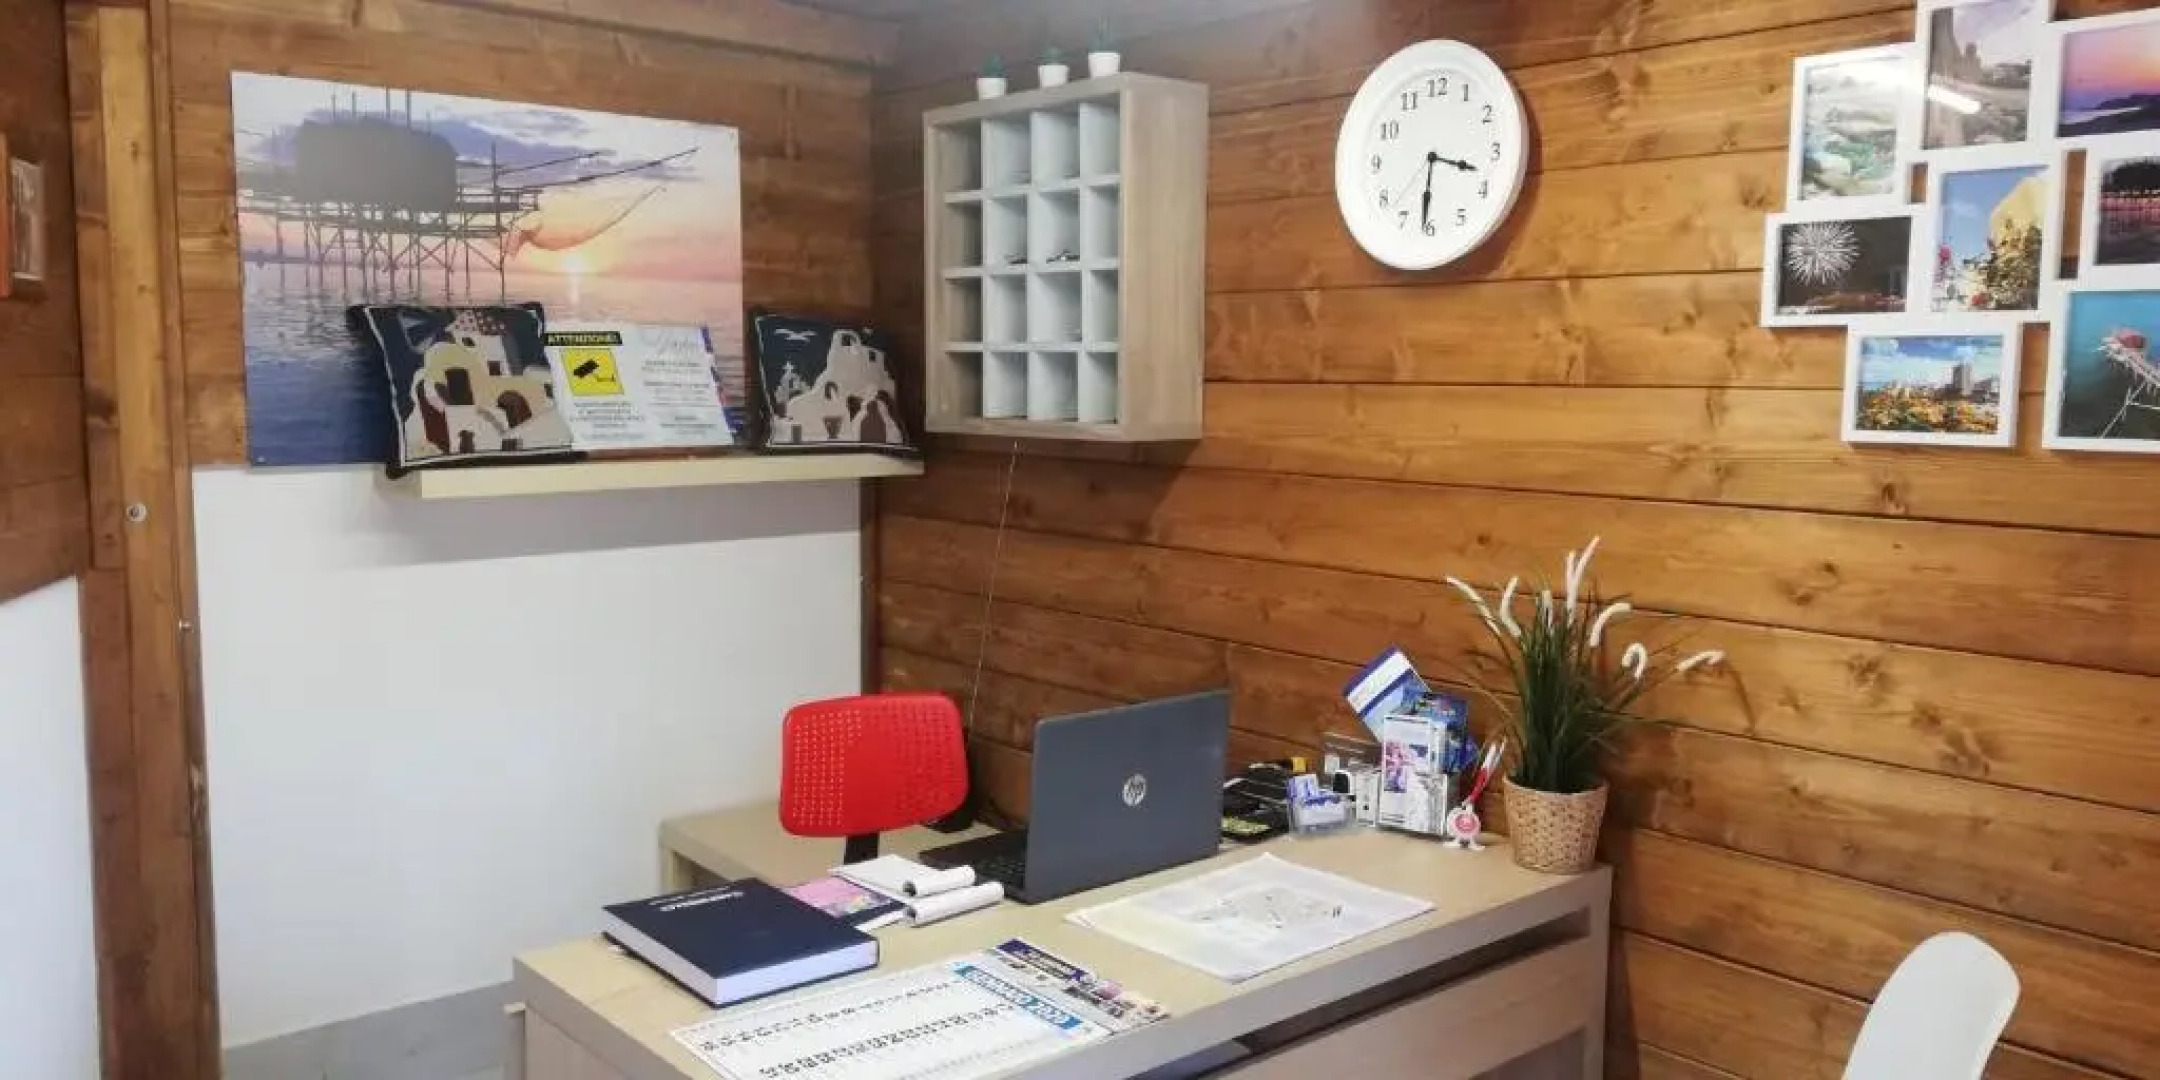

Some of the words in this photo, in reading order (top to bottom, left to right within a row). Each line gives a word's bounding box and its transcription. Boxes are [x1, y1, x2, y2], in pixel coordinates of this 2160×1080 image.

[1427, 78, 1447, 97] 12
[1401, 91, 1418, 110] 11
[1482, 104, 1492, 124] 2
[1379, 120, 1399, 139] 10
[1491, 142, 1500, 161] 3
[1372, 154, 1382, 173] 9
[1380, 189, 1389, 207] 8
[1478, 180, 1488, 198] 4
[1398, 210, 1409, 228] 7
[1455, 209, 1466, 226] 5
